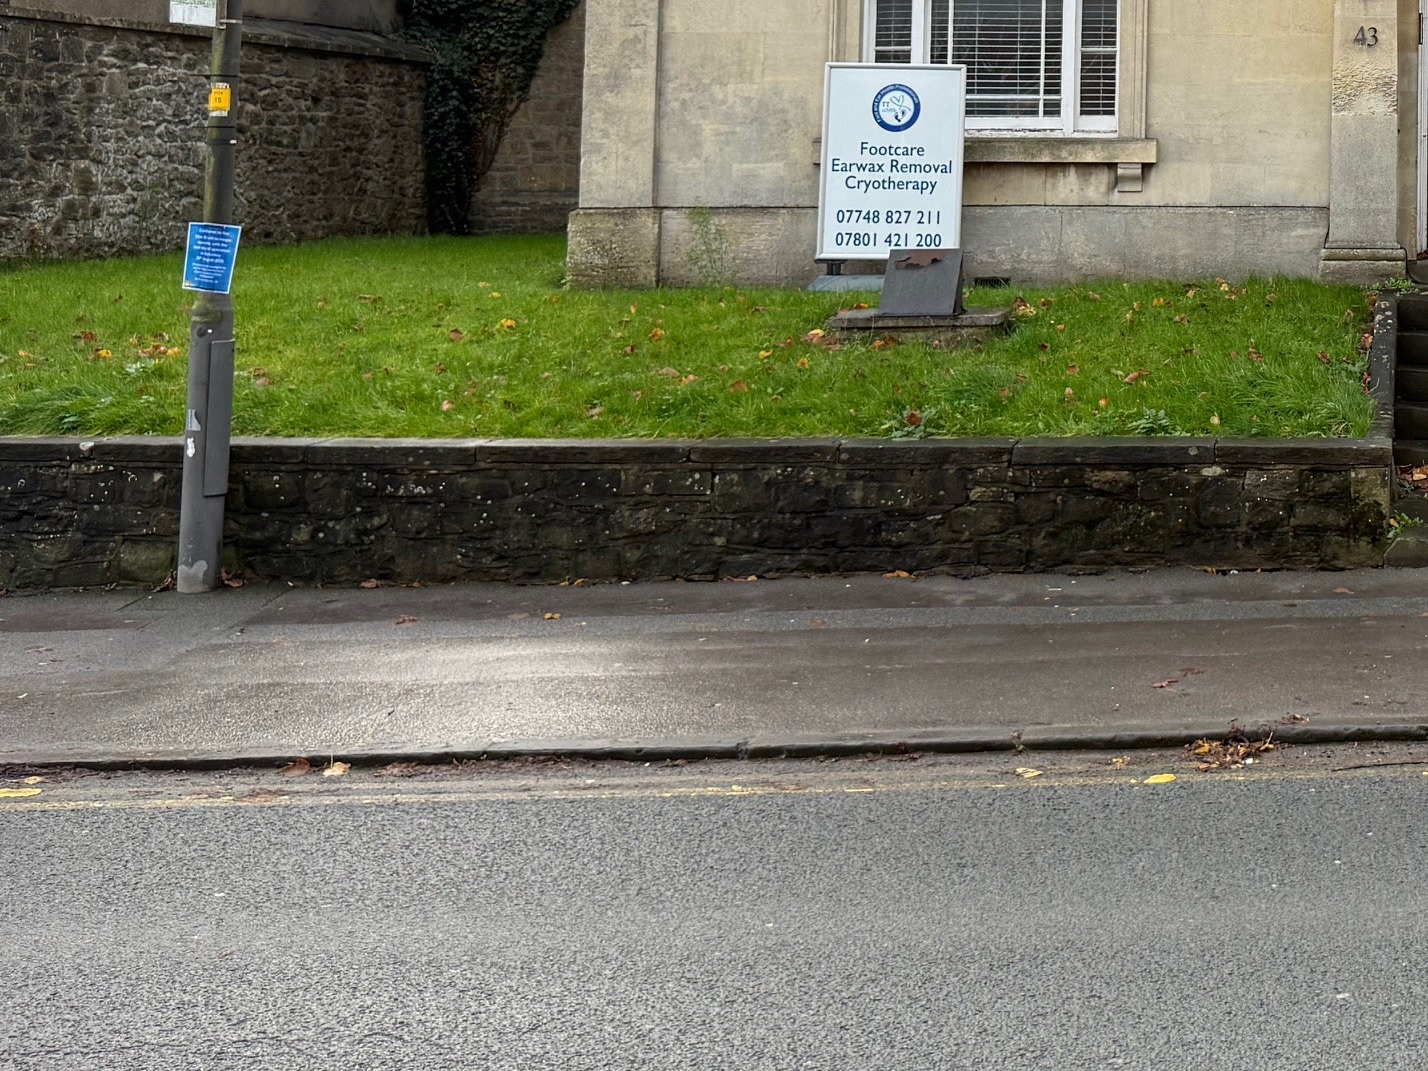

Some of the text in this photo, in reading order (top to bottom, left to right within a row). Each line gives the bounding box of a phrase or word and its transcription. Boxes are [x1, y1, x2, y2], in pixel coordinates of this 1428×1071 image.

[1353, 25, 1379, 47] 43
[860, 142, 925, 157] Footcare
[831, 158, 952, 174] Earwax Removal
[845, 175, 938, 195] Cryotherapy
[836, 209, 941, 225] 07748 827 211
[835, 232, 942, 248] 07801 421 200
